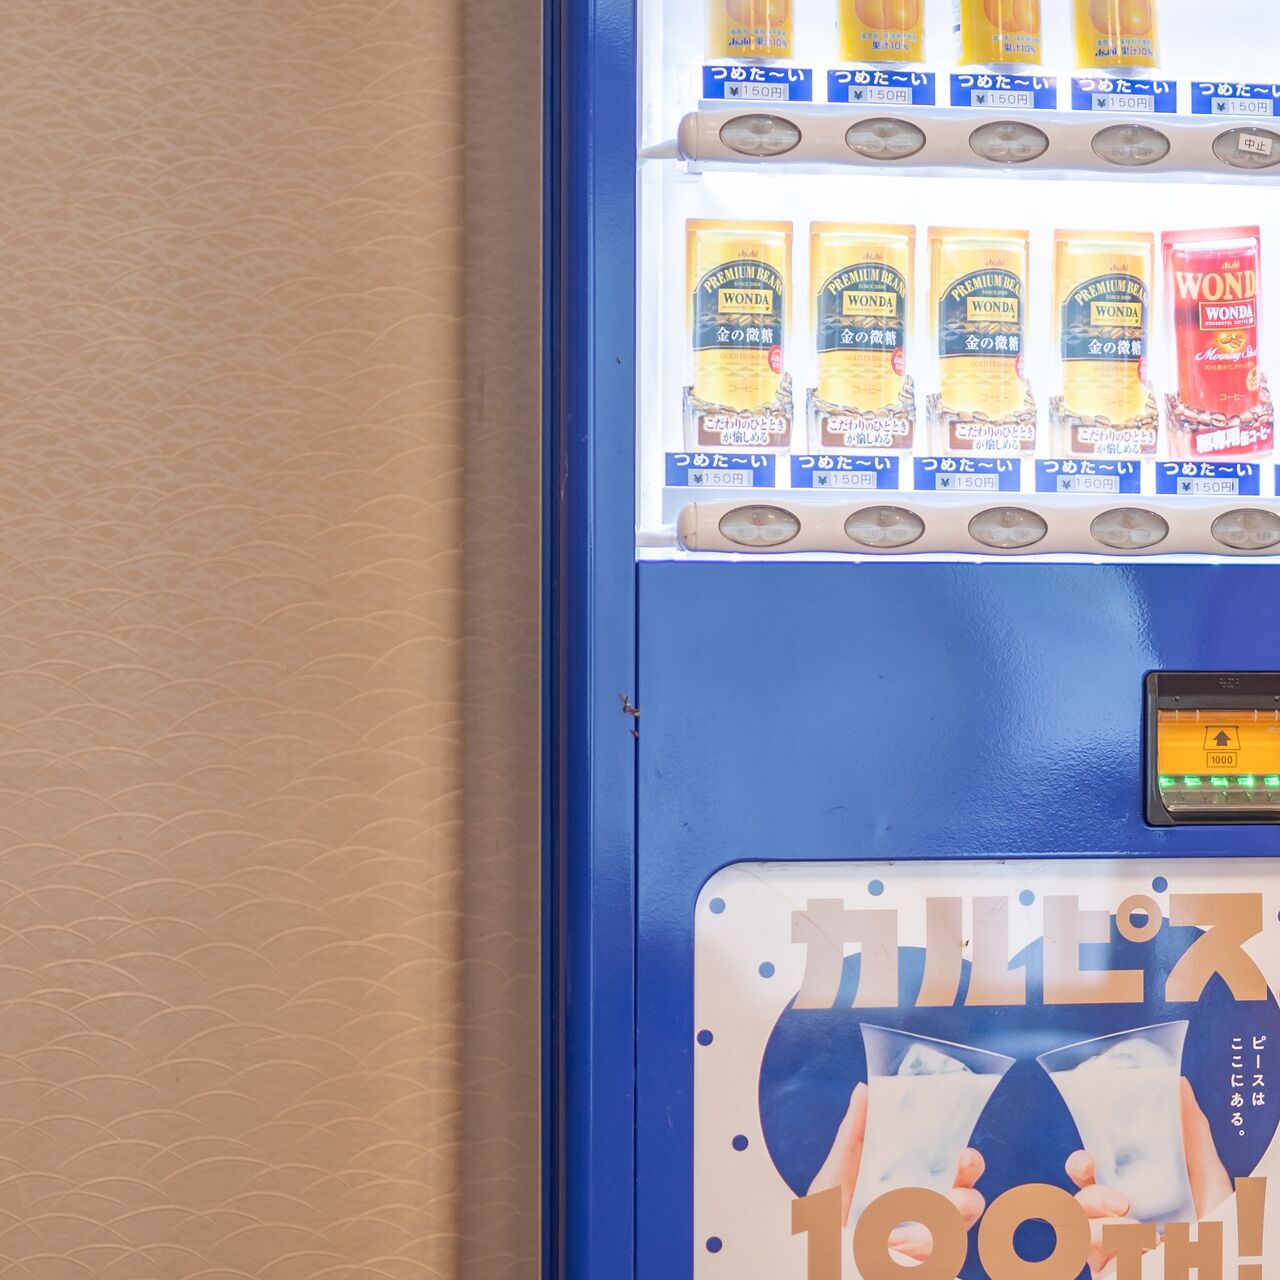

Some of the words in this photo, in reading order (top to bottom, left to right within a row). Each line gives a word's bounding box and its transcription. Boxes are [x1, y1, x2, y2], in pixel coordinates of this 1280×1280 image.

[1244, 137, 1267, 152] 中止
[703, 266, 755, 294] PREMIUM
[827, 269, 879, 296] PREMIUM
[1175, 270, 1256, 301] WOND
[951, 276, 1002, 303] PREMIUM
[1074, 280, 1125, 307] PREMIUM
[723, 292, 770, 305] WONDA
[847, 294, 893, 308] WONDA
[972, 300, 1016, 314] WONDA
[1095, 305, 1138, 319] WONDA
[715, 326, 774, 344] 金の微糖
[839, 328, 897, 347] 金の微糖
[964, 334, 1020, 352] 金の微糖
[1087, 338, 1142, 355] 金の微糖
[1195, 347, 1242, 362] Morning
[1219, 393, 1247, 401] コーヒー
[706, 418, 784, 432] こだわりのひととき
[829, 419, 908, 434] こだわりのひととき
[958, 425, 1035, 439] こだわりのひととき
[1079, 429, 1155, 444] こだわりのひととき
[1211, 755, 1233, 764] 1000
[791, 893, 1268, 1010] カルピス
[1252, 1035, 1267, 1107] ピースは
[1230, 1036, 1245, 1137] ここにある。
